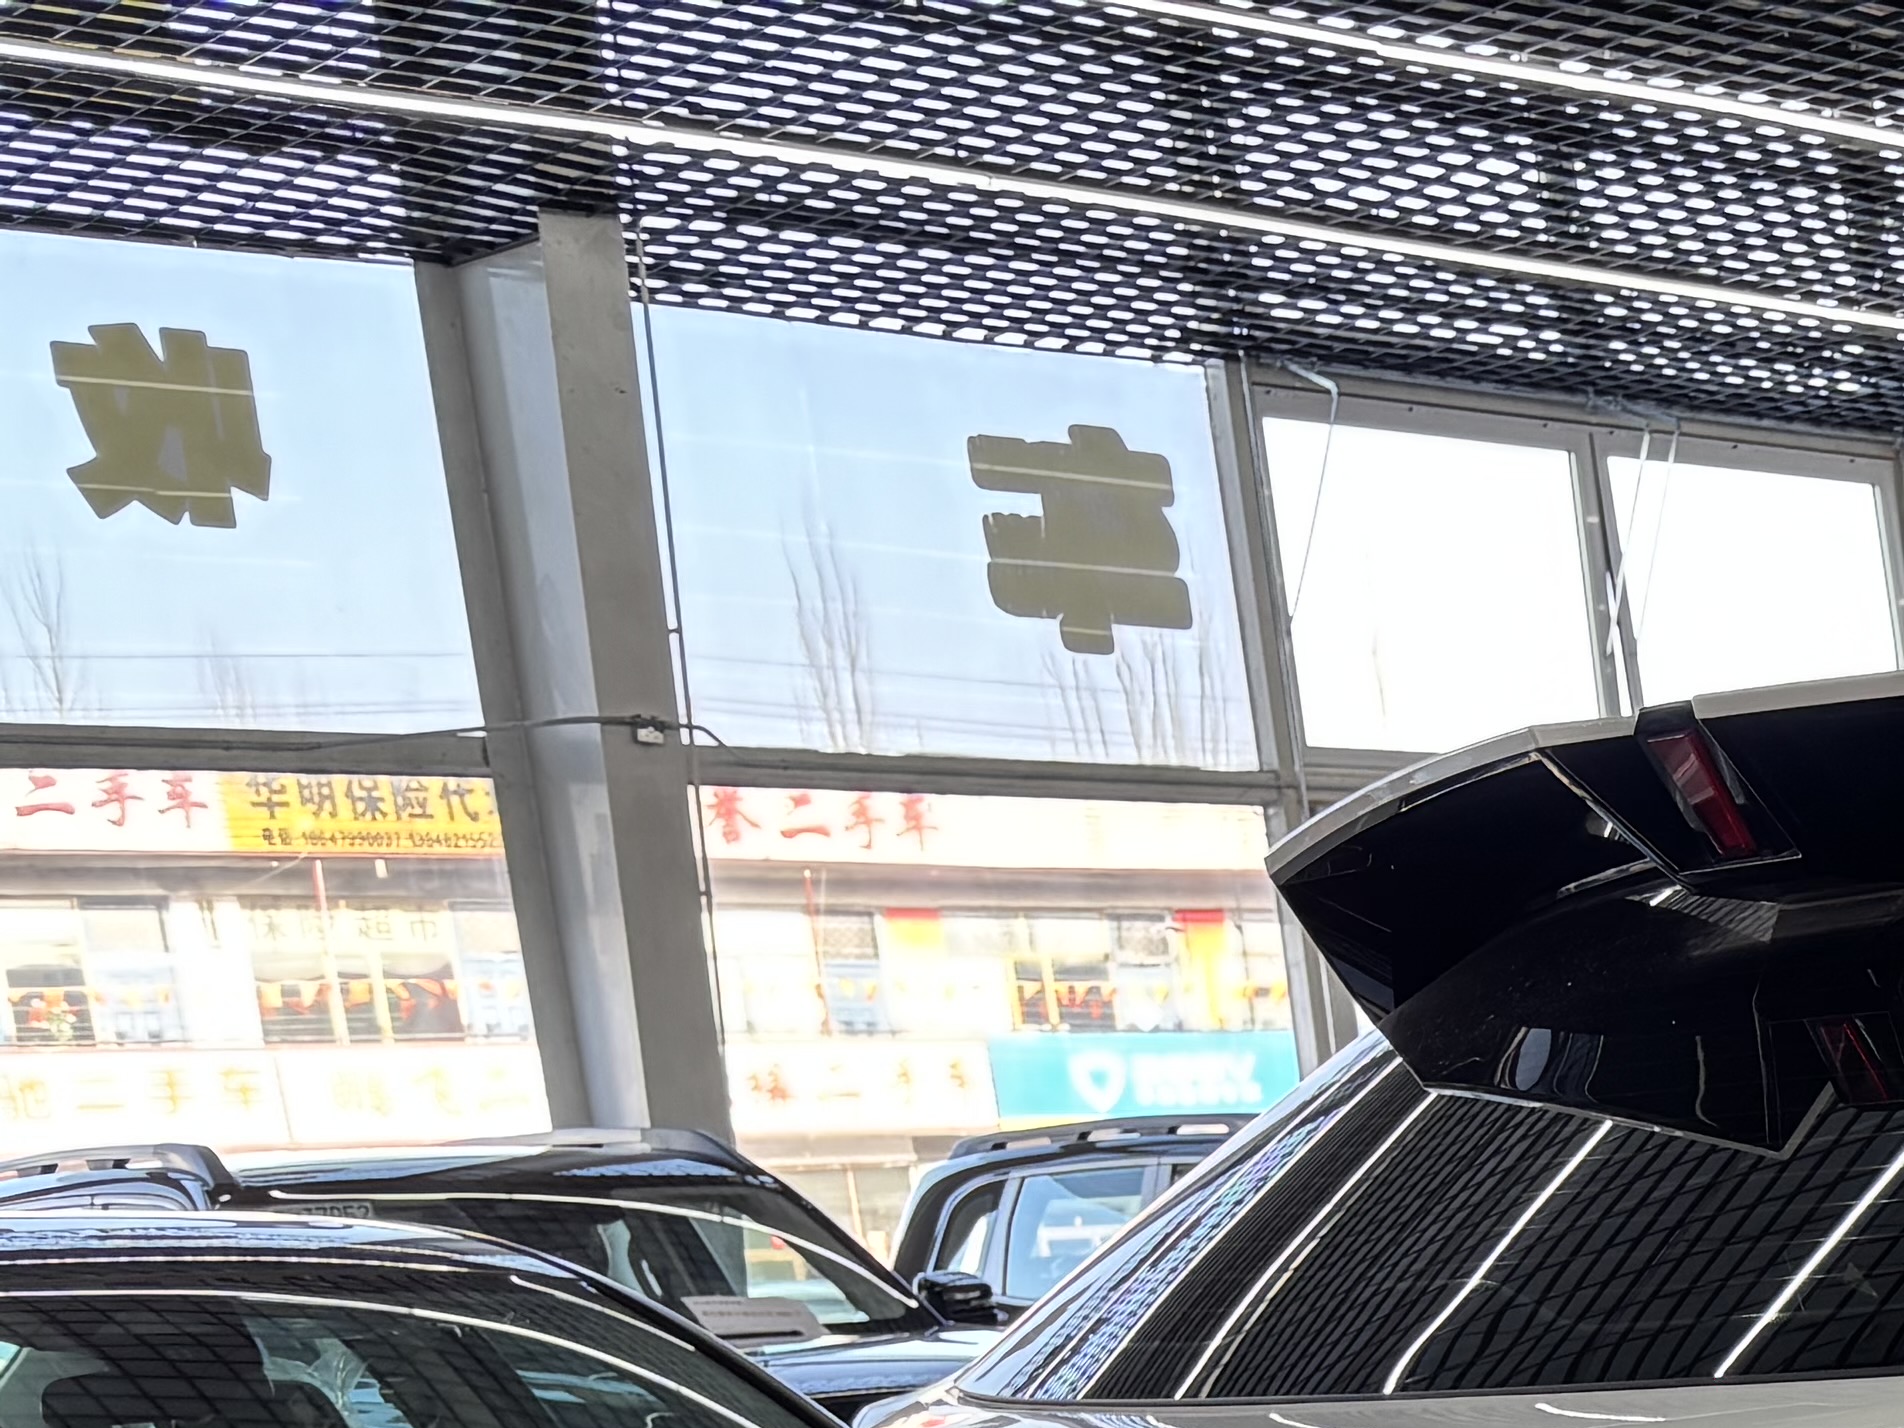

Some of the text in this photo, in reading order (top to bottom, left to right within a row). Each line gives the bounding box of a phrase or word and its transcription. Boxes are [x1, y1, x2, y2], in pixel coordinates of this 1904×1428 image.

[246, 775, 494, 821] 华明保险代
